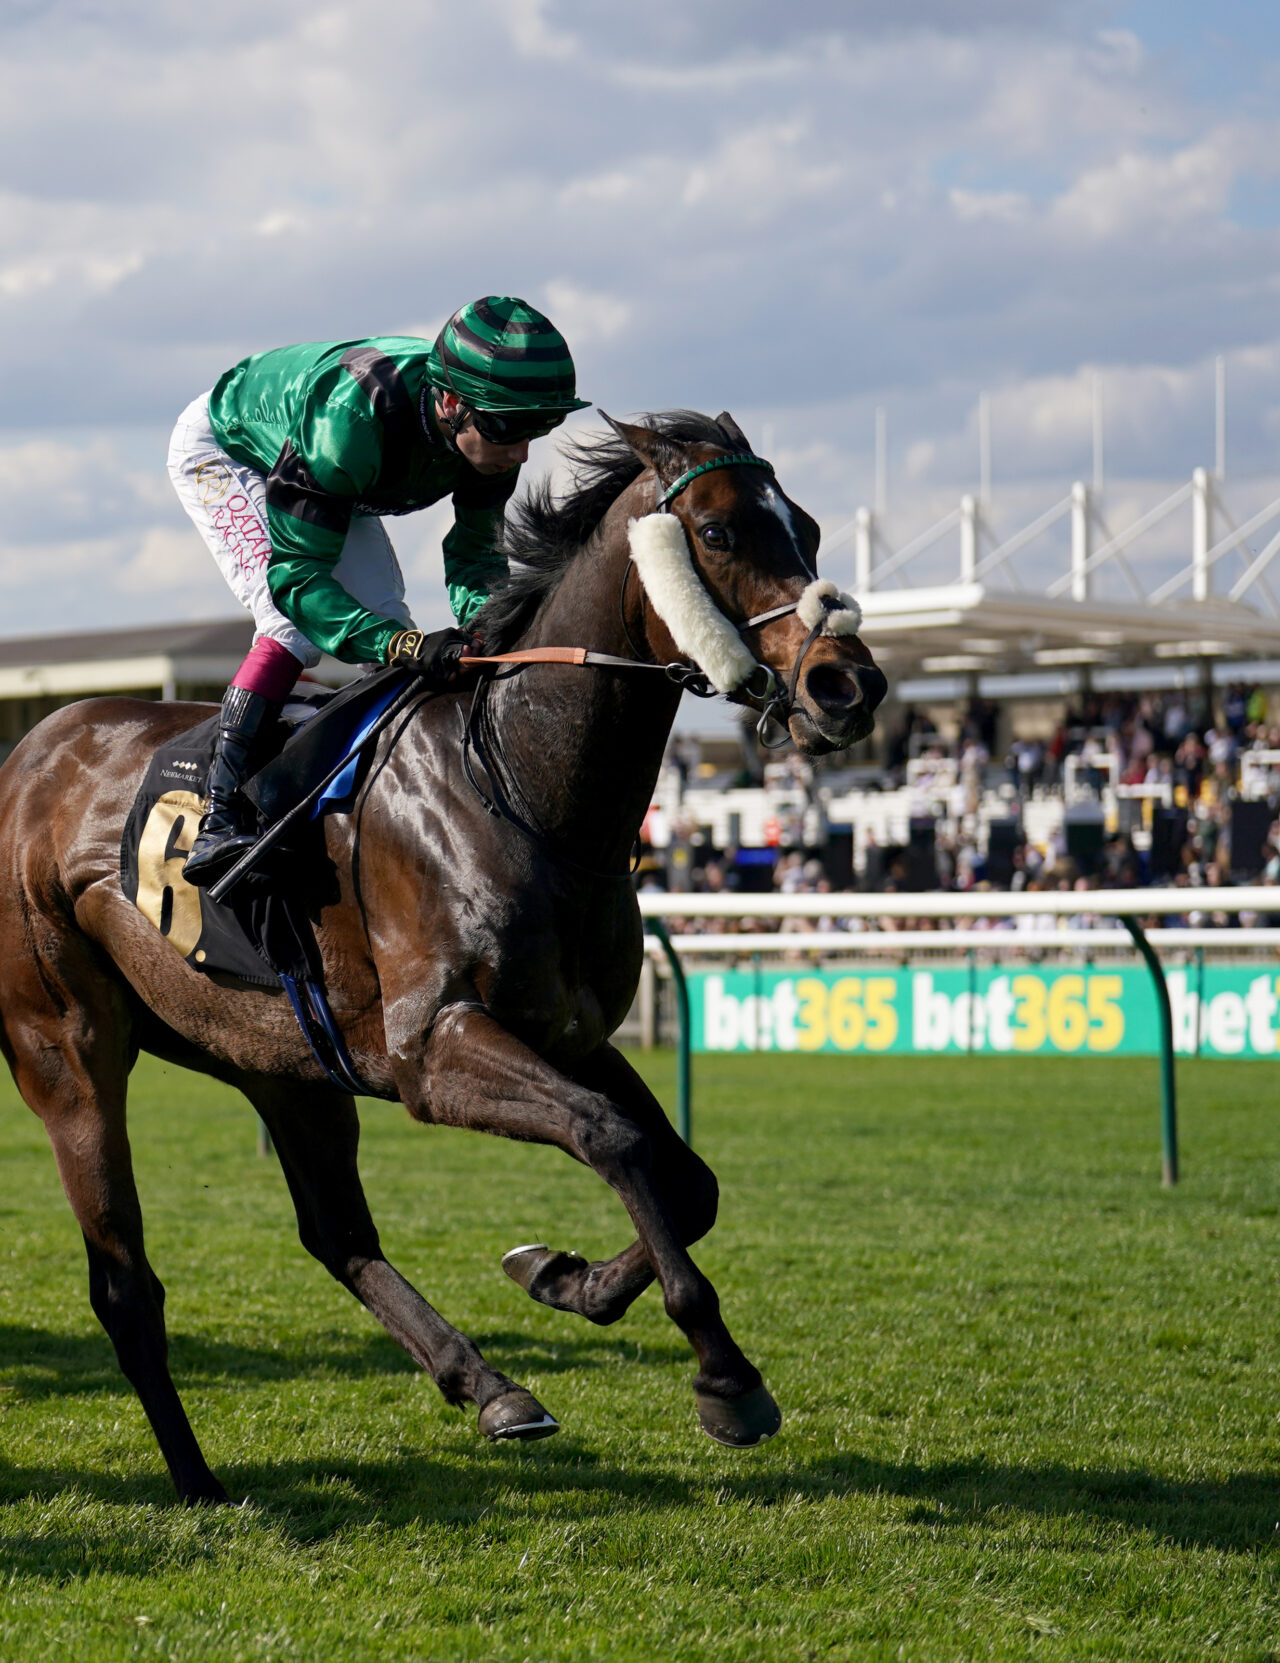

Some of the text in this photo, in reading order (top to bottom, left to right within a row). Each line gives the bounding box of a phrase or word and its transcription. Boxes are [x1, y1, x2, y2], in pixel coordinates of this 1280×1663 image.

[212, 508, 255, 581] RACING
[226, 494, 272, 571] QATAR
[160, 769, 202, 783] NEWMARKET
[704, 975, 899, 1051] bet365
[912, 971, 1125, 1051] bet365
[1166, 970, 1280, 1055] bet
